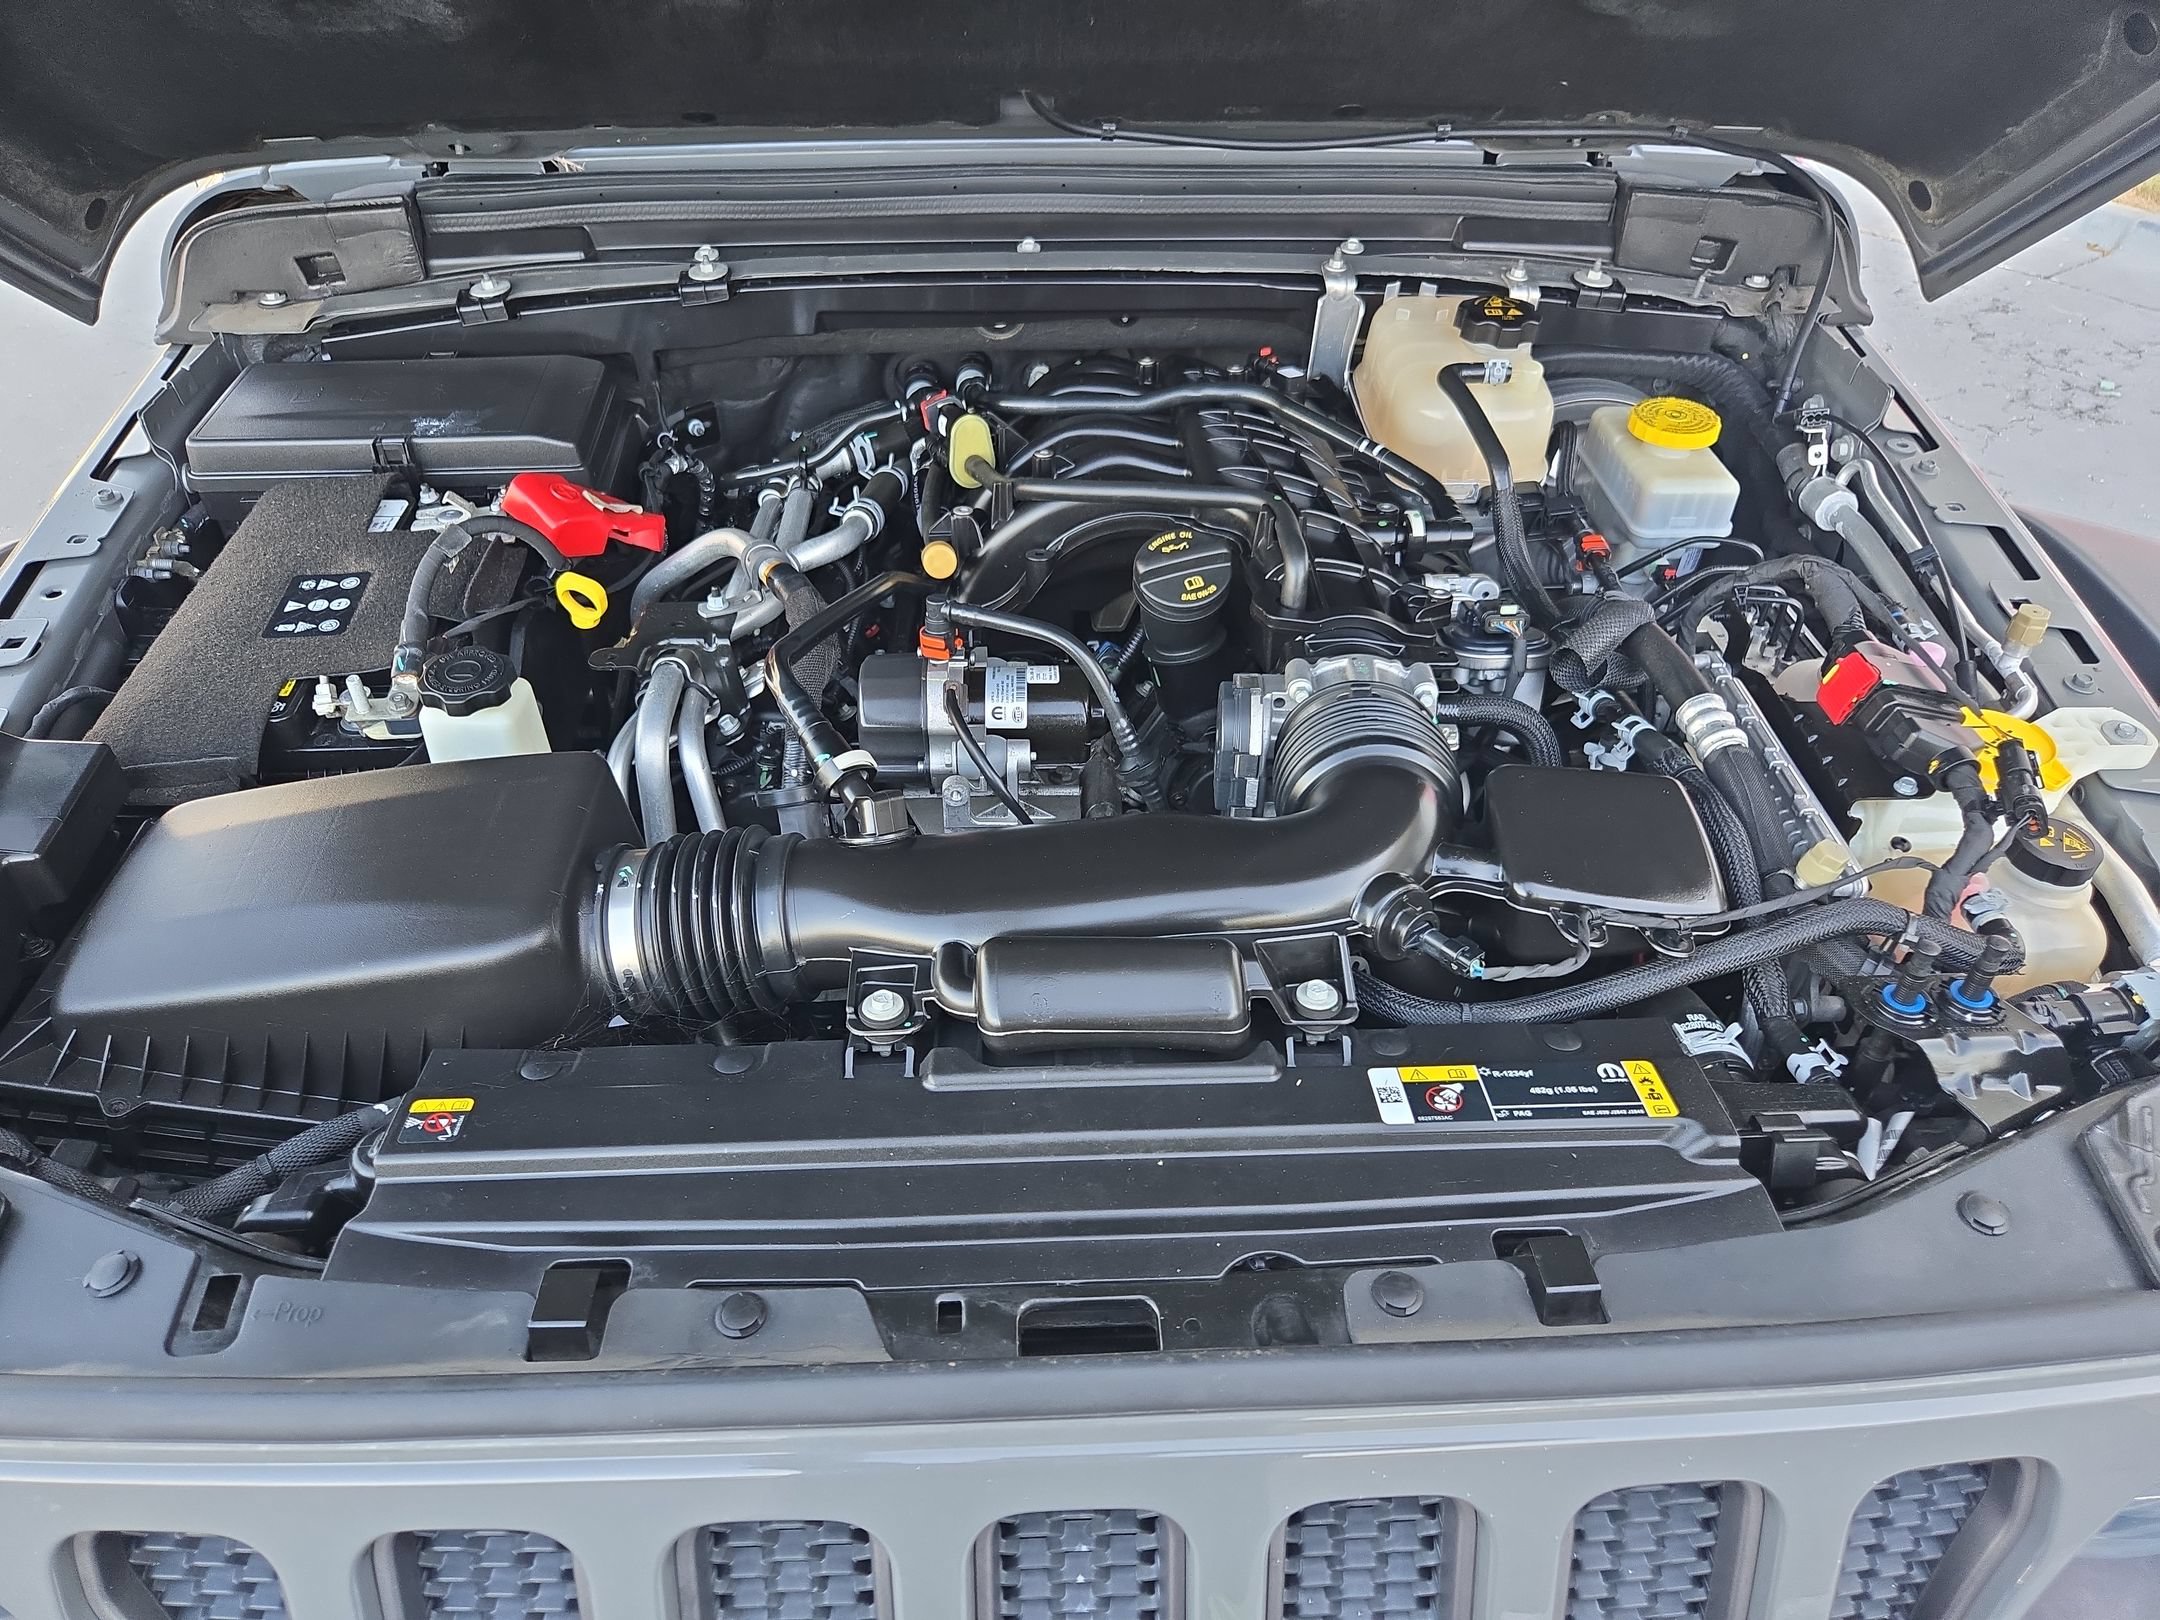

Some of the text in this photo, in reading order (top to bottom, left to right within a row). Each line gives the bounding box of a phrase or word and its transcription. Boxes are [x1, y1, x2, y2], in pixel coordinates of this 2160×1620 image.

[1148, 531, 1193, 551] ENGINE OIL
[1181, 592, 1197, 601] SAE
[1493, 1069, 1533, 1079] R-1234yf
[272, 1300, 323, 1328] Prop
